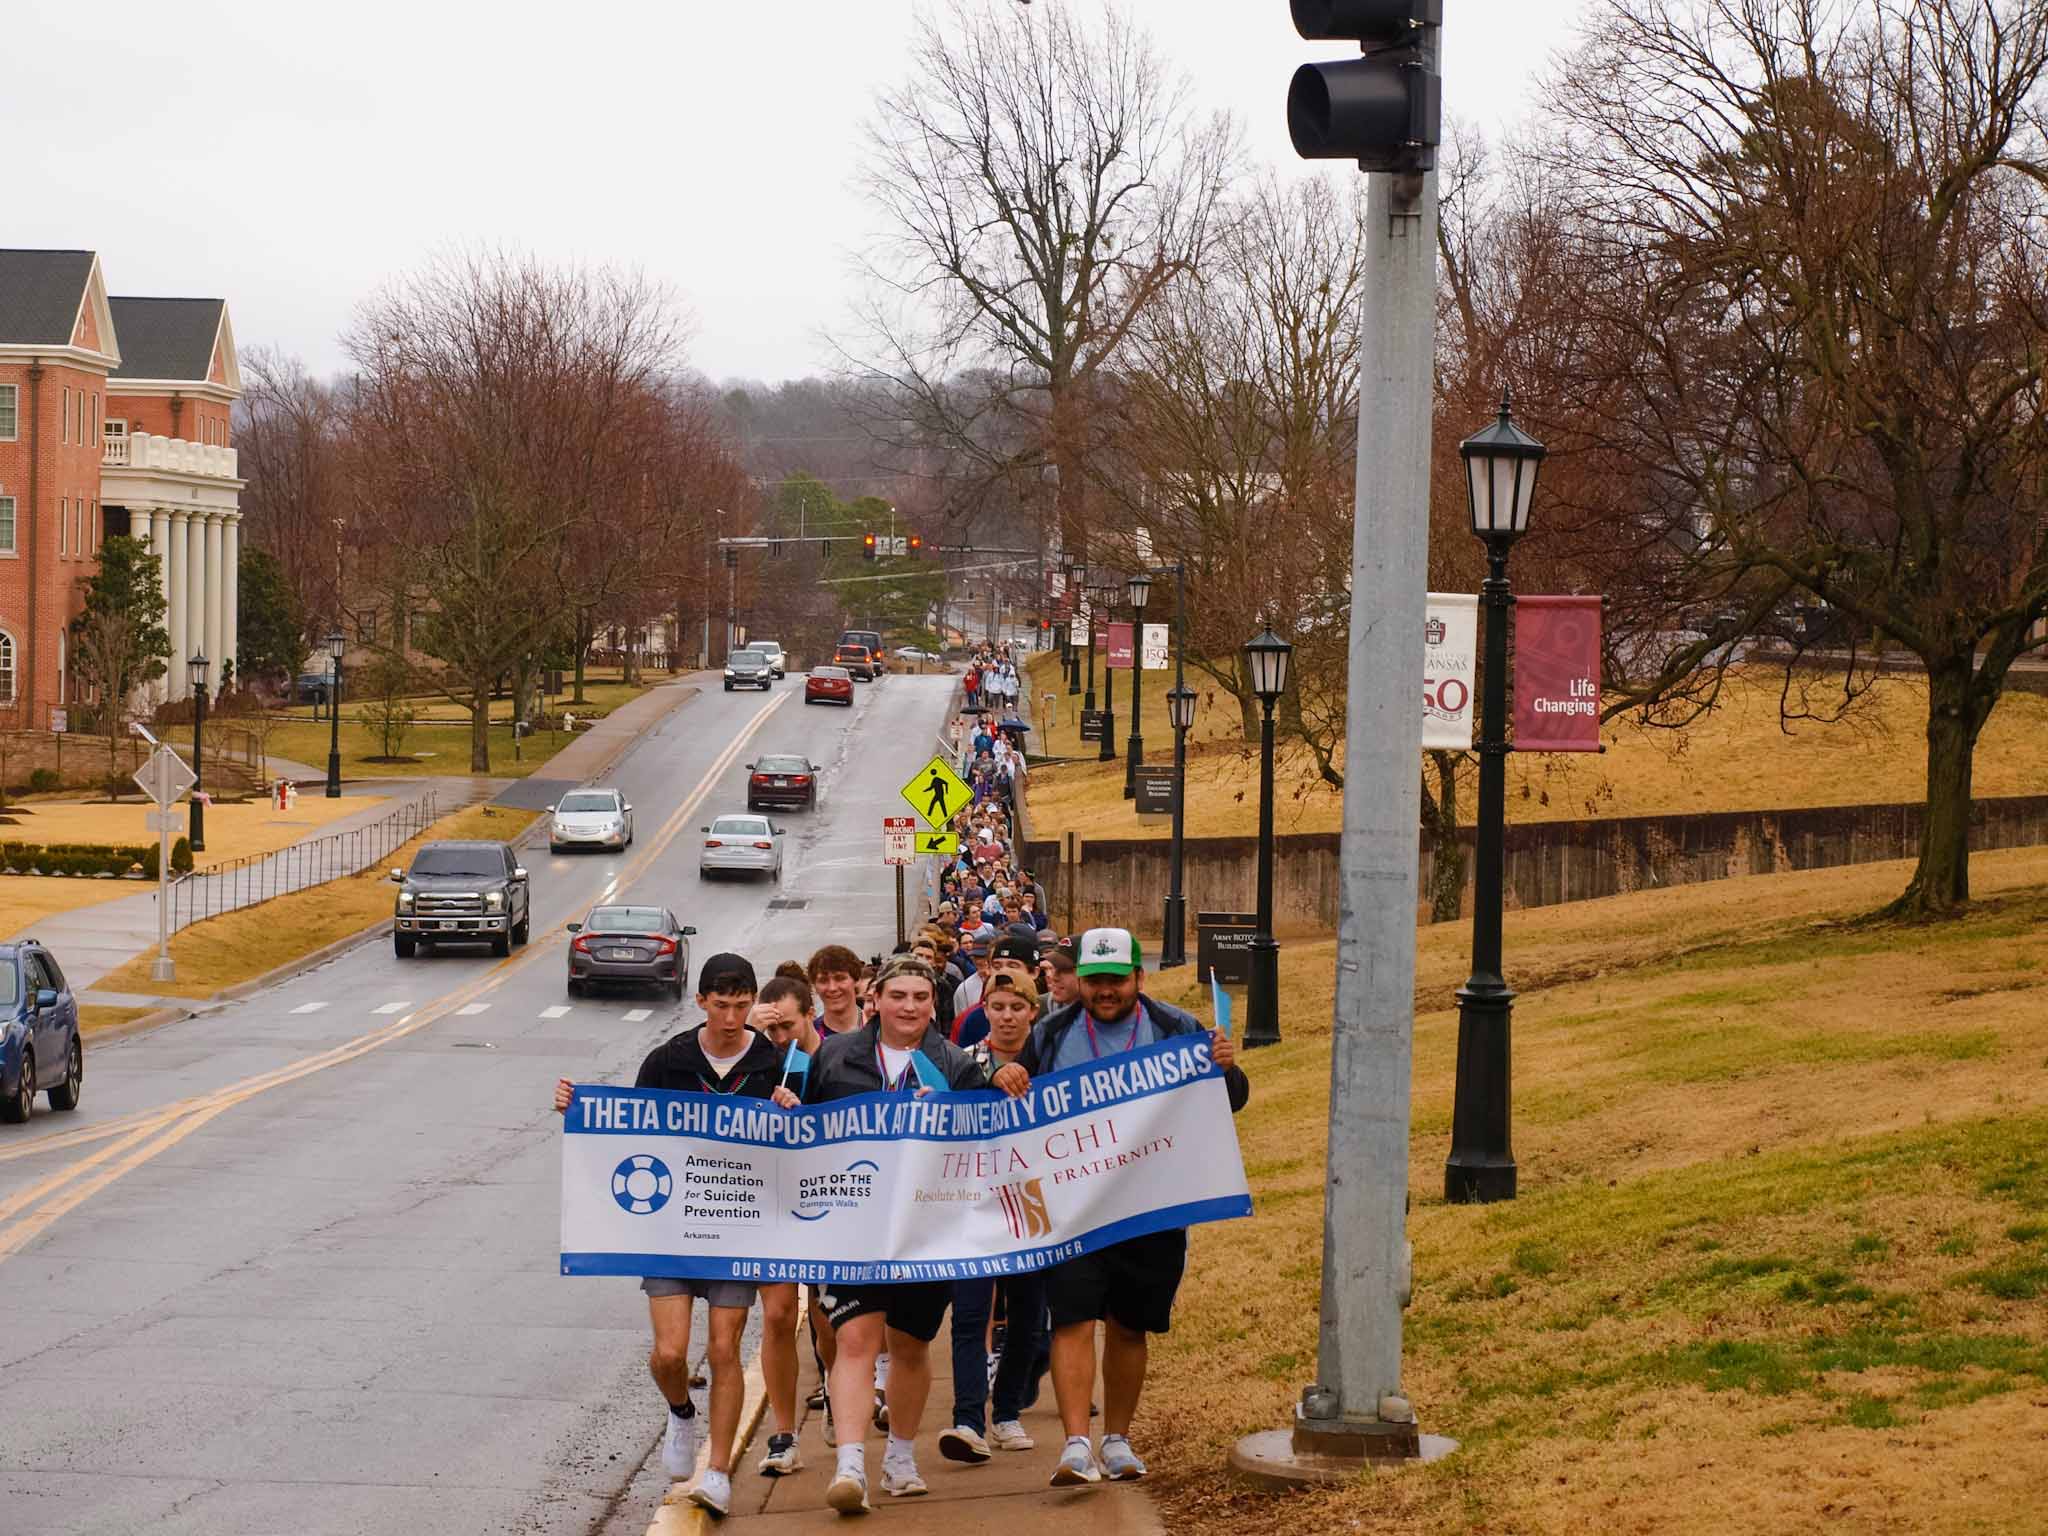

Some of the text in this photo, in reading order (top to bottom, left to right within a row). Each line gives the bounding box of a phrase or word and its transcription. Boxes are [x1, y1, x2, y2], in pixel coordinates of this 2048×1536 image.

[1423, 678, 1469, 713] 50
[1569, 679, 1596, 697] Life
[1534, 698, 1596, 716] Changing
[893, 818, 906, 826] NO
[885, 826, 914, 834] PARKING
[580, 1042, 1212, 1145] THETA CHI CAMPUS WALK AT THE UNIVERSITY OF ARKANSAS
[942, 1118, 1120, 1179] THETA CHI
[685, 1155, 752, 1171] American
[1052, 1135, 1176, 1185] FRATERNITY
[685, 1172, 764, 1188] Foundation
[800, 1174, 872, 1187] OUT OF THE
[684, 1189, 756, 1203] for Suicide
[800, 1187, 872, 1199] DARKNESS
[914, 1190, 981, 1201] Resolute Men
[684, 1205, 761, 1219] Prevention
[800, 1199, 859, 1210] Campus Walks
[683, 1231, 721, 1241] Arkansas
[732, 1261, 761, 1278] OUR
[768, 1262, 827, 1280] SACRED
[875, 1263, 956, 1281] COMMITTING
[960, 1261, 978, 1275] TO
[982, 1258, 1010, 1274] ONE
[1016, 1240, 1084, 1271] ANOTHER
